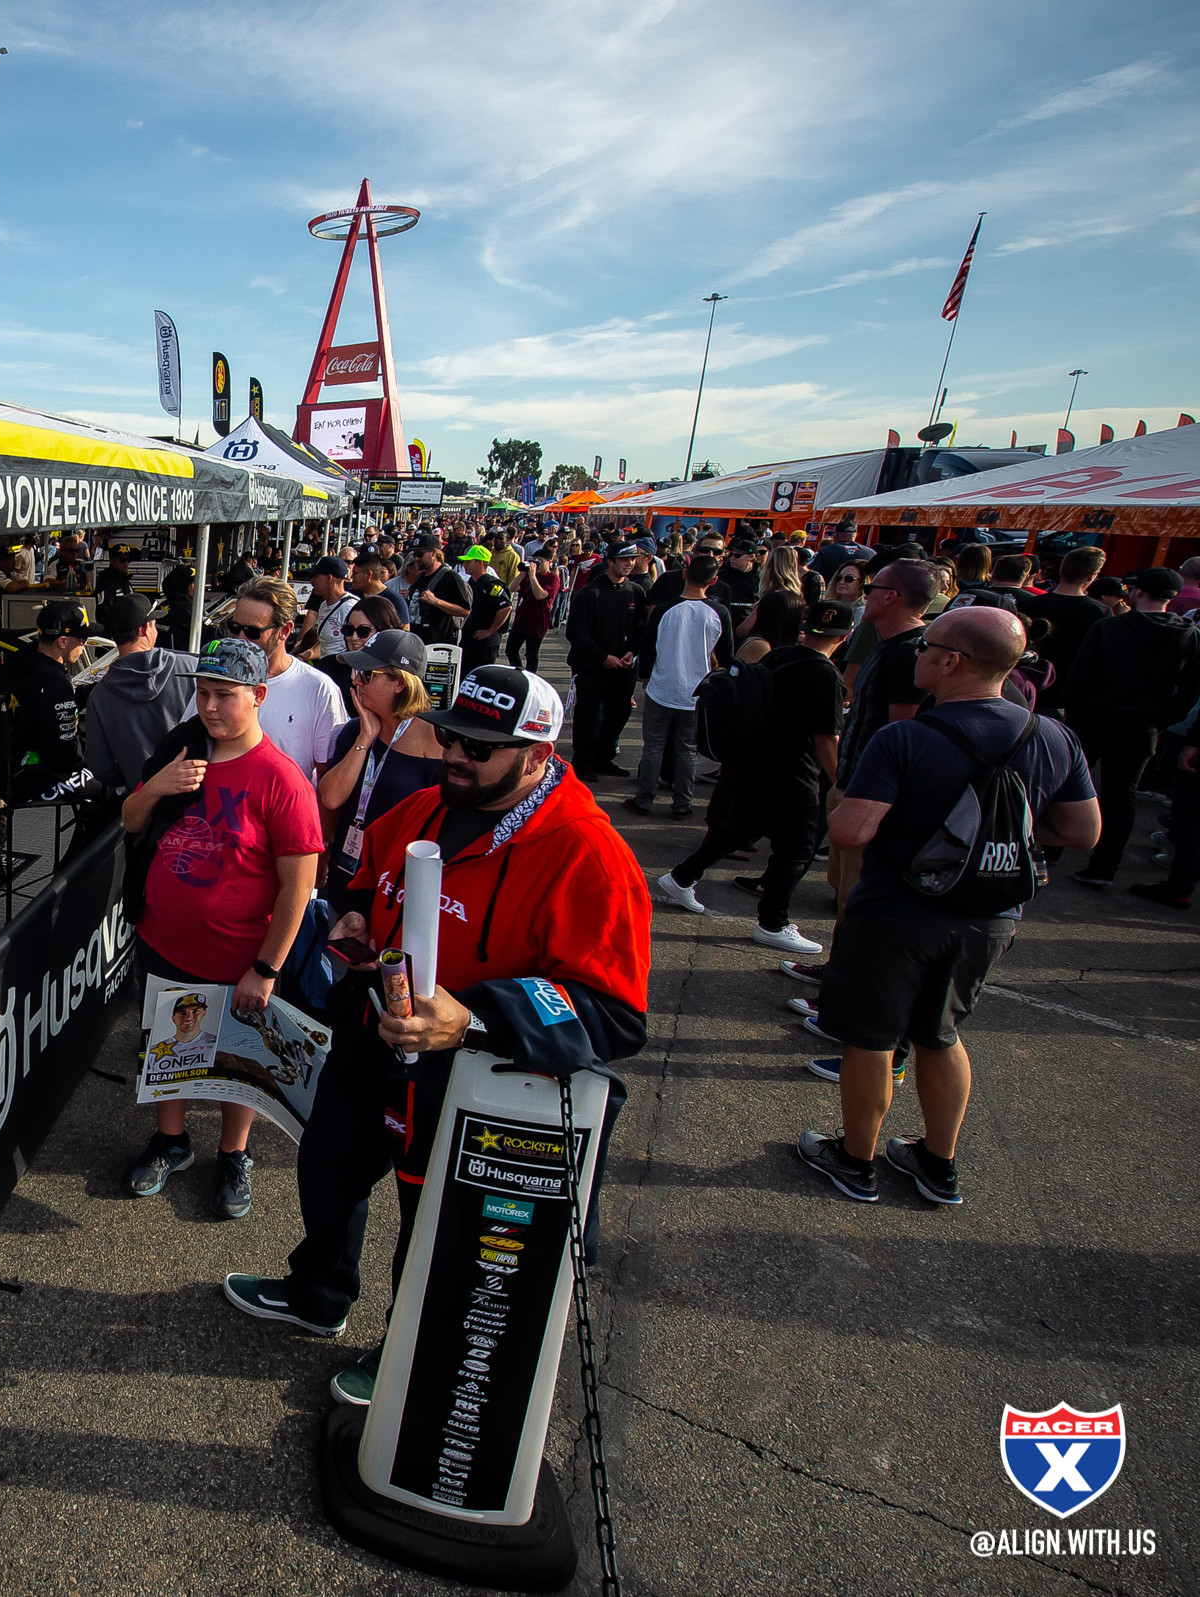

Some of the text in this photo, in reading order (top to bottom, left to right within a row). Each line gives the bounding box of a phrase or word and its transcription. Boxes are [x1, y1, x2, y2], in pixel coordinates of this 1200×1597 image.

[126, 481, 168, 523] SINCE
[171, 487, 195, 522] 1903
[459, 680, 516, 711] GEICO
[382, 880, 468, 922] HODA
[486, 1165, 562, 1189] Husqvarna
[486, 1204, 530, 1219] MOTOREX
[466, 1315, 507, 1327] DUNLOP
[471, 1324, 506, 1335] SCOTT
[447, 1419, 480, 1433] GALFER
